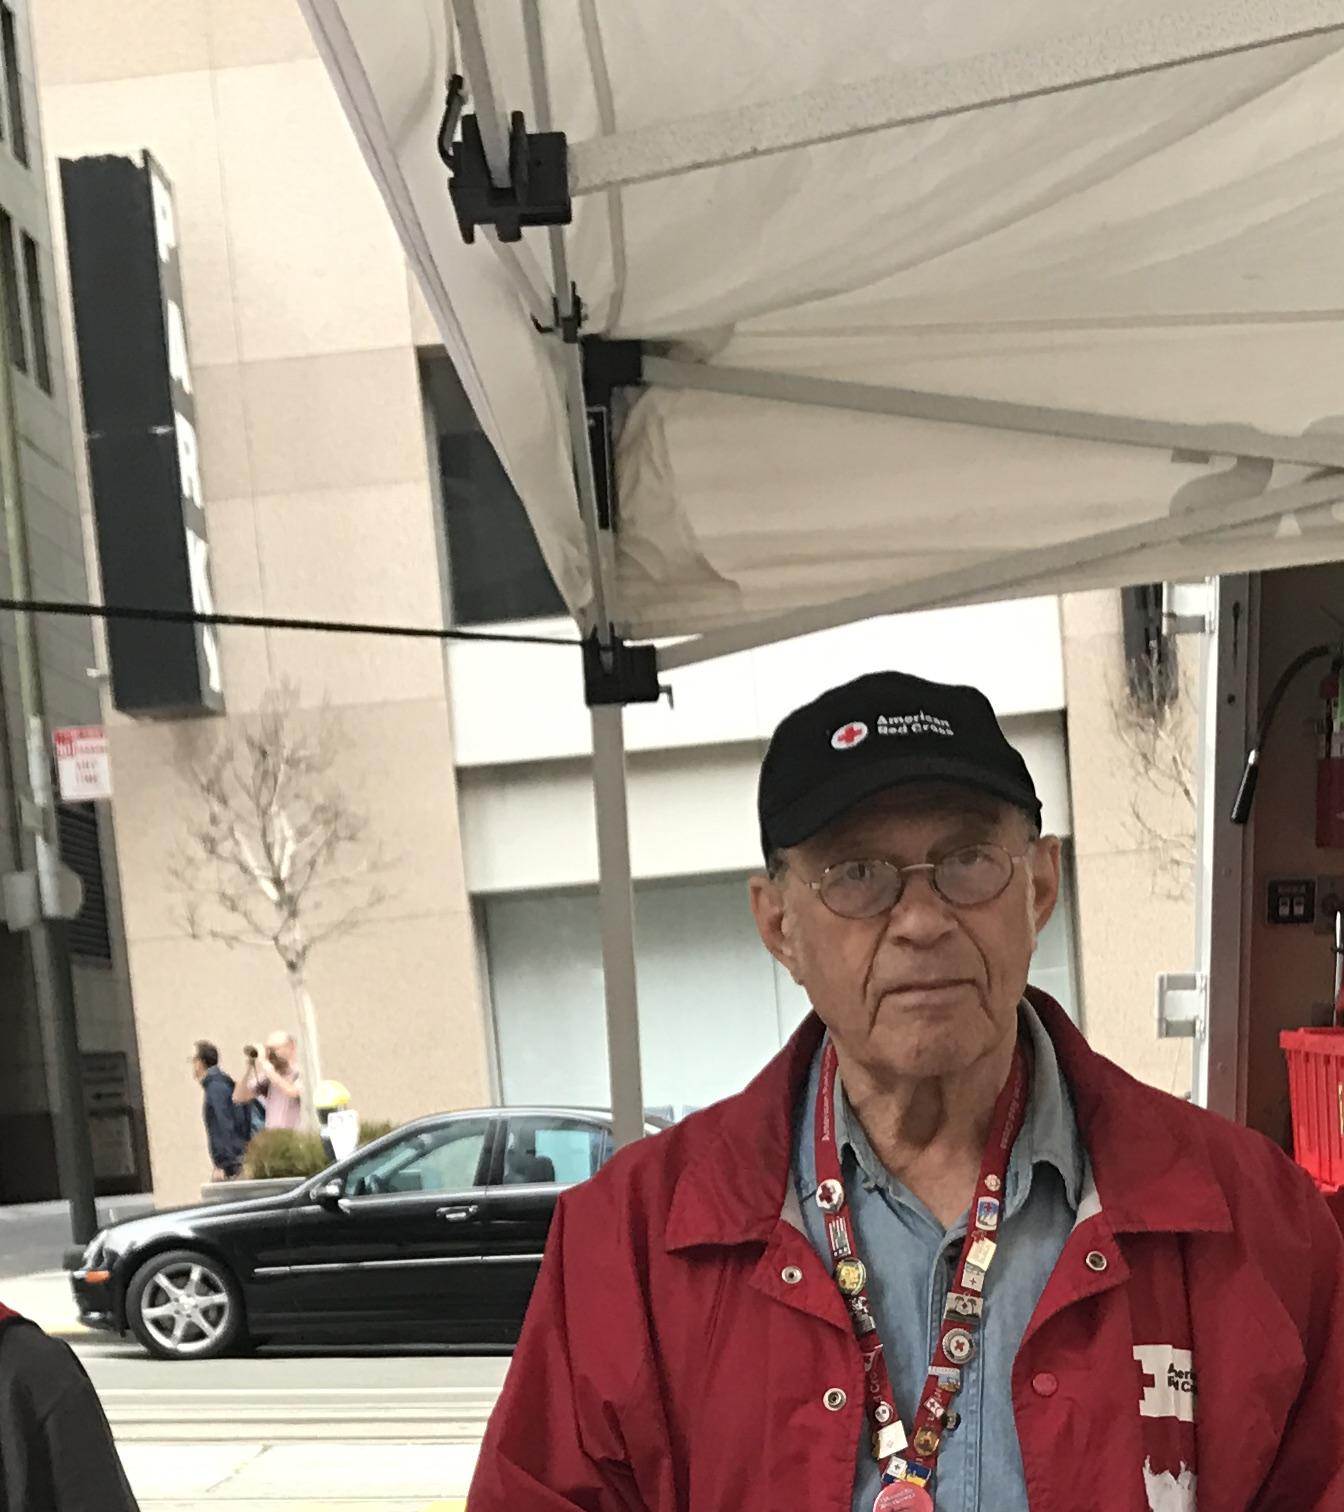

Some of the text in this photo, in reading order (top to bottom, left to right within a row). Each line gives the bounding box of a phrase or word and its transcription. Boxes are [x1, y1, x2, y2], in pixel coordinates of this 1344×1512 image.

[877, 710, 951, 728] American
[877, 722, 954, 736] Red Cross
